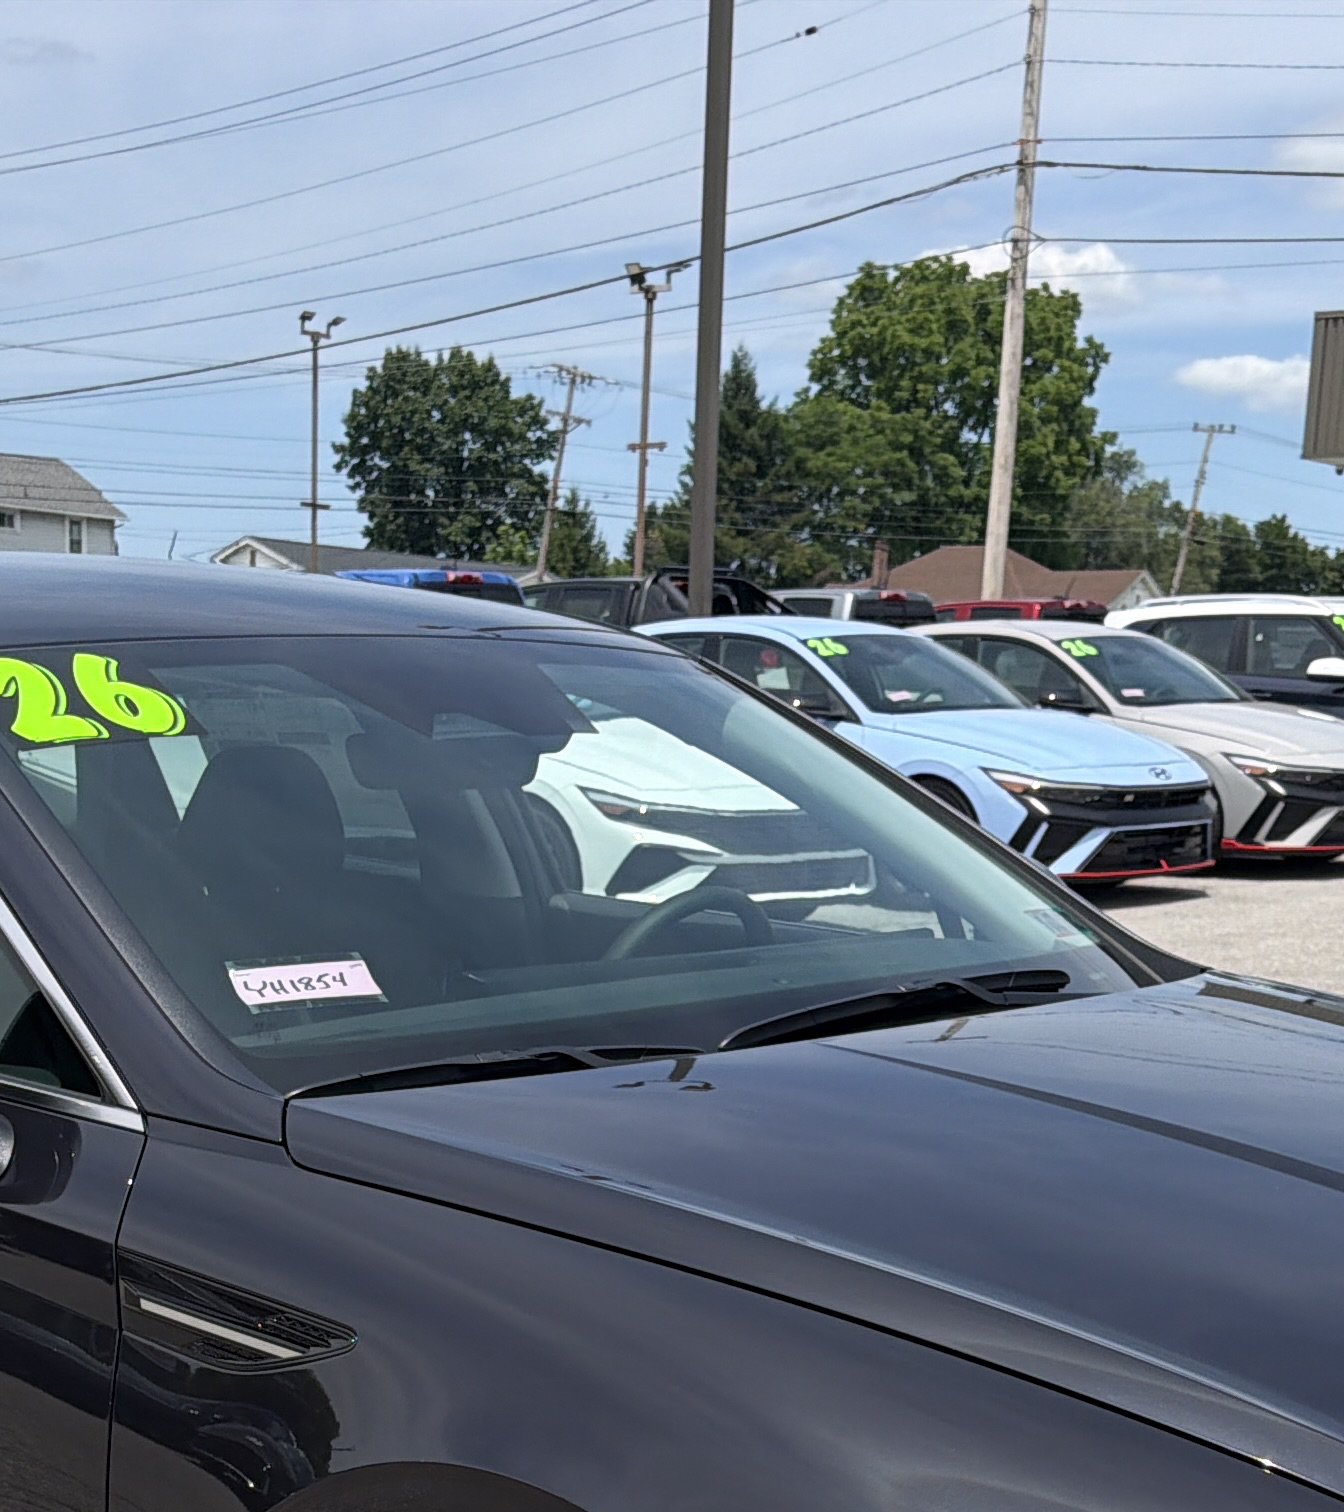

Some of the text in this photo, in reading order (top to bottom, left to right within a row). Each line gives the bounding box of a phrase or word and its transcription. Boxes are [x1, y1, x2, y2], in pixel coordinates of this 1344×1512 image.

[807, 638, 849, 657] 26
[1061, 639, 1099, 657] 26
[242, 971, 348, 998] YH1854
